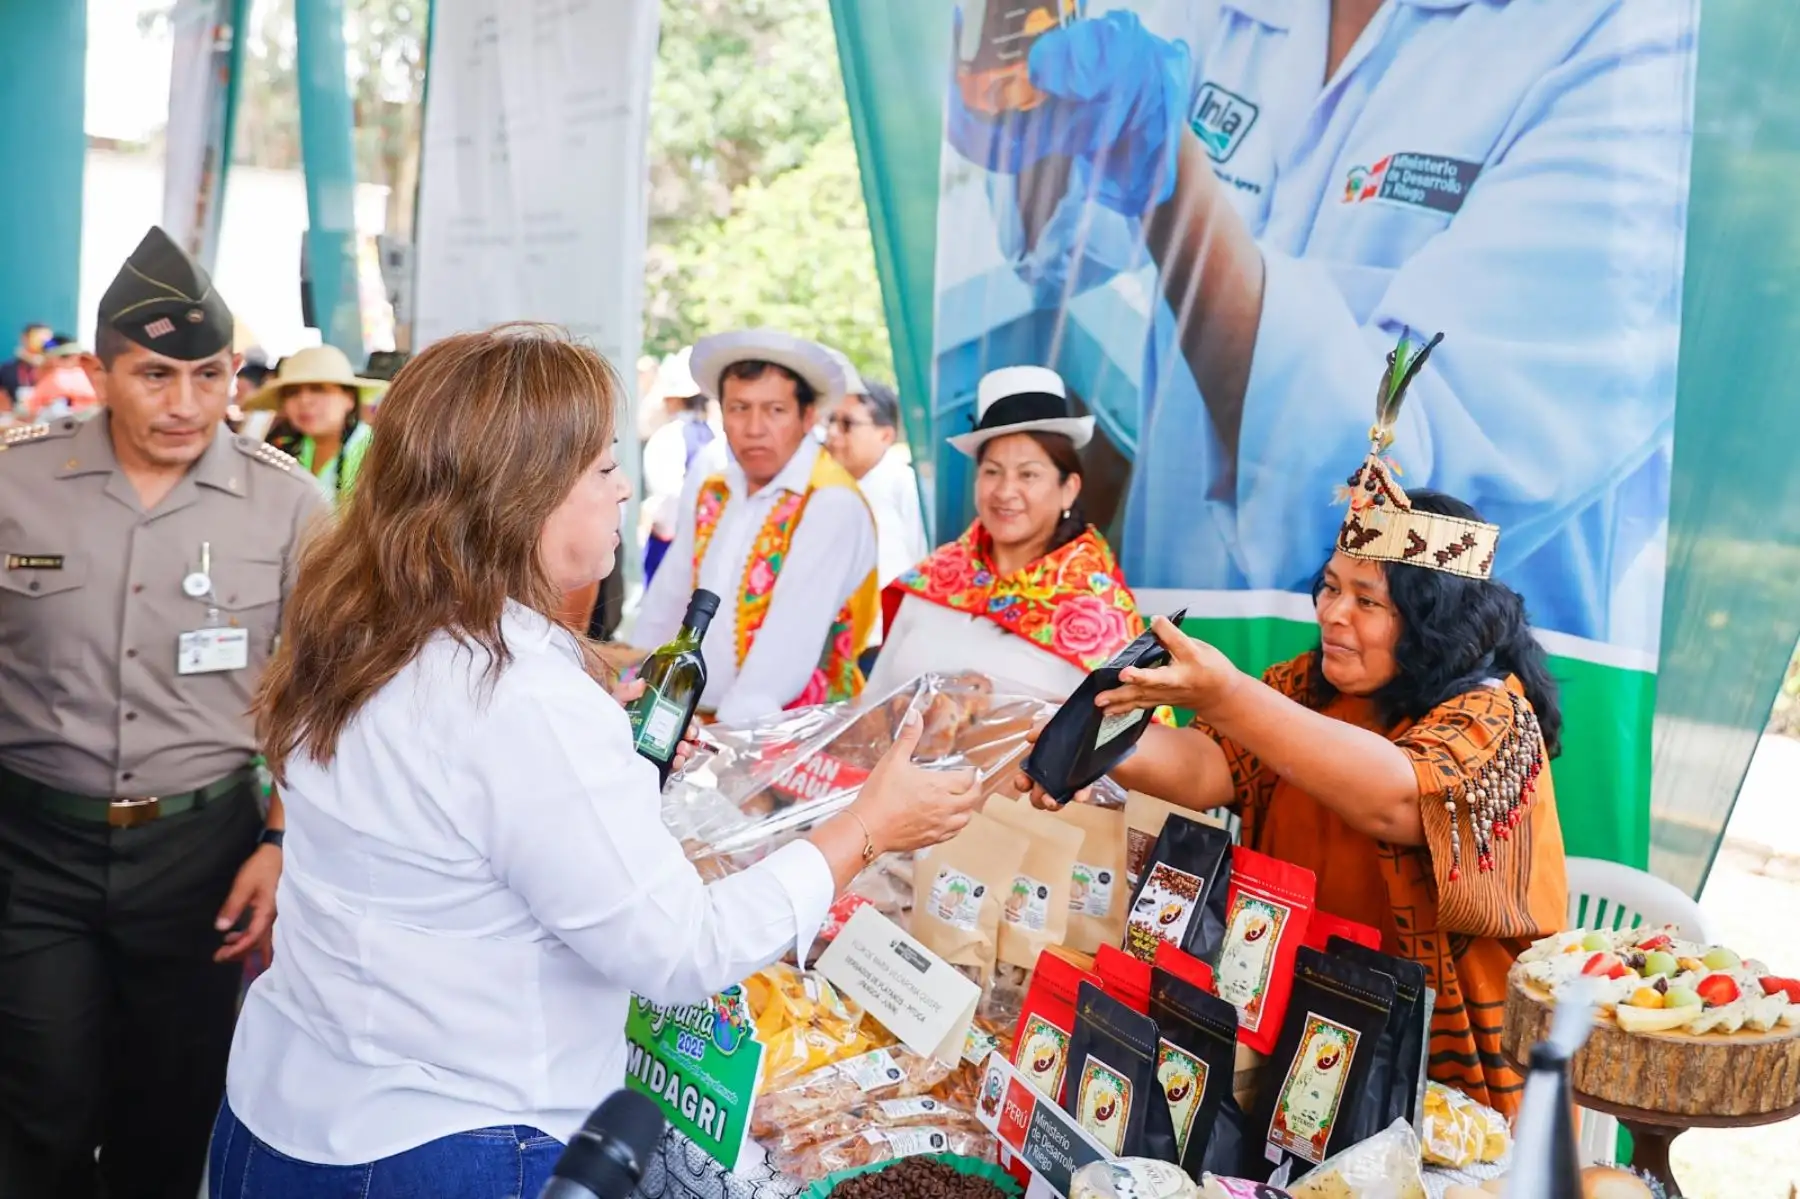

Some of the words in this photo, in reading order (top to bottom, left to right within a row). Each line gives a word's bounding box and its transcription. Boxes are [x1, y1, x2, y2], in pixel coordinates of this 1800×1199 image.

[1393, 154, 1458, 176] Ministerio
[1386, 168, 1400, 182] de
[1402, 168, 1462, 194] Desarrollo
[1394, 182, 1426, 203] Riego
[677, 1032, 706, 1060] 2025
[628, 1040, 727, 1143] MIDAGRI
[1004, 1099, 1028, 1129] PERÚ
[1034, 1110, 1070, 1150] Ministerio
[1026, 1141, 1033, 1155] y
[1033, 1144, 1053, 1171] Riego
[1031, 1126, 1041, 1142] de
[1041, 1134, 1077, 1174] Desarrollo
